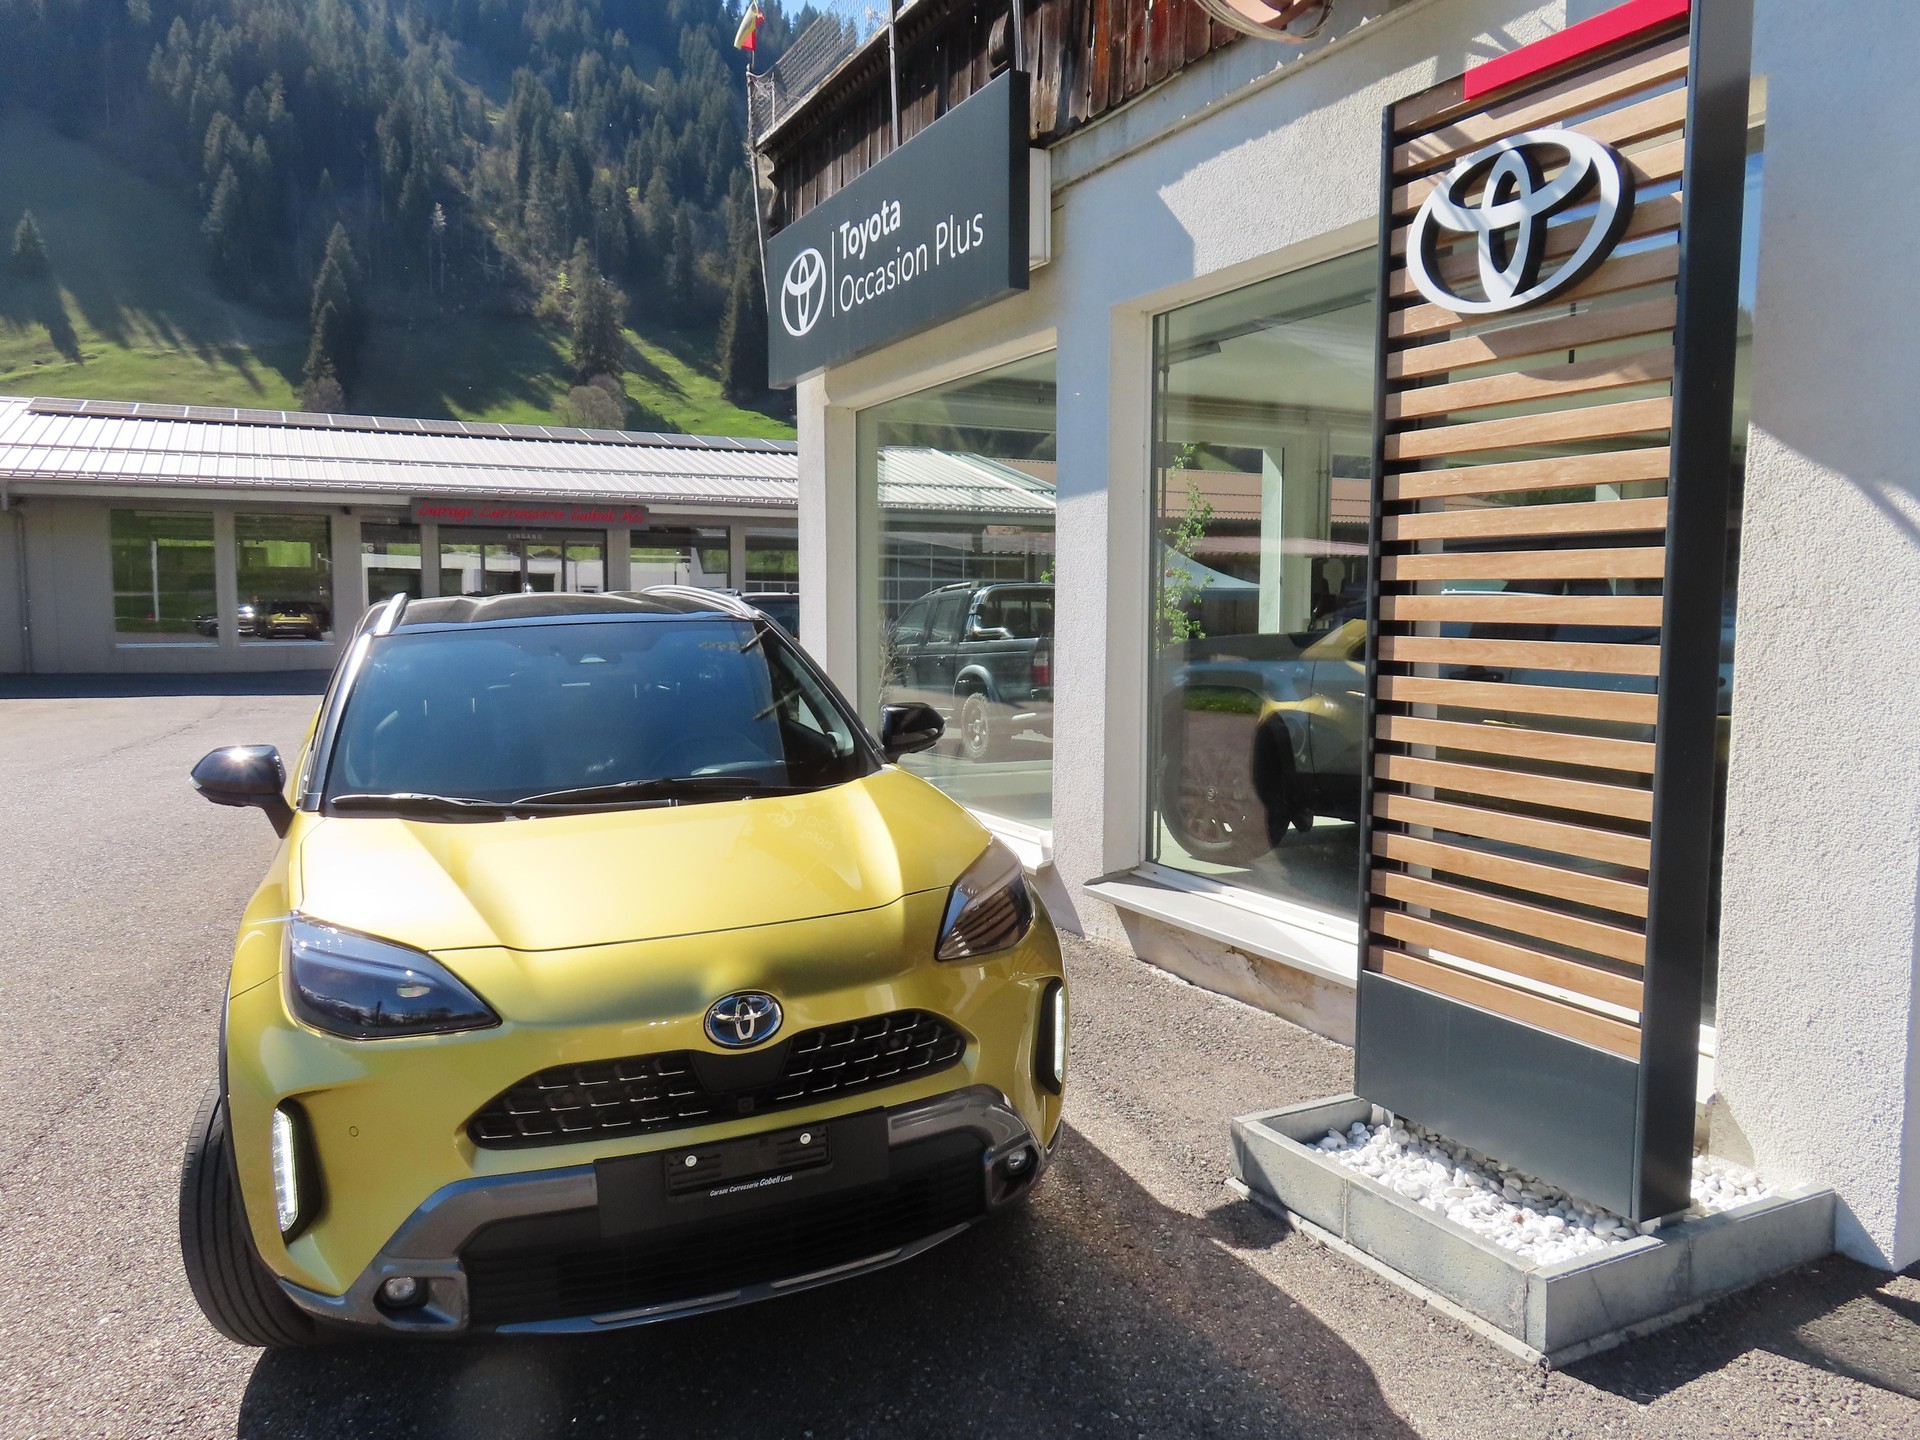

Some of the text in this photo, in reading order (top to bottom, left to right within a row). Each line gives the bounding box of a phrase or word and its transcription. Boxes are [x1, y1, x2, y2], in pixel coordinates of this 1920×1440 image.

[839, 199, 901, 260] Toyota
[839, 212, 984, 311] Occasion Plus
[507, 532, 543, 541] EINGANG
[709, 1188, 729, 1197] Garage
[729, 1181, 759, 1193] Carrosserie
